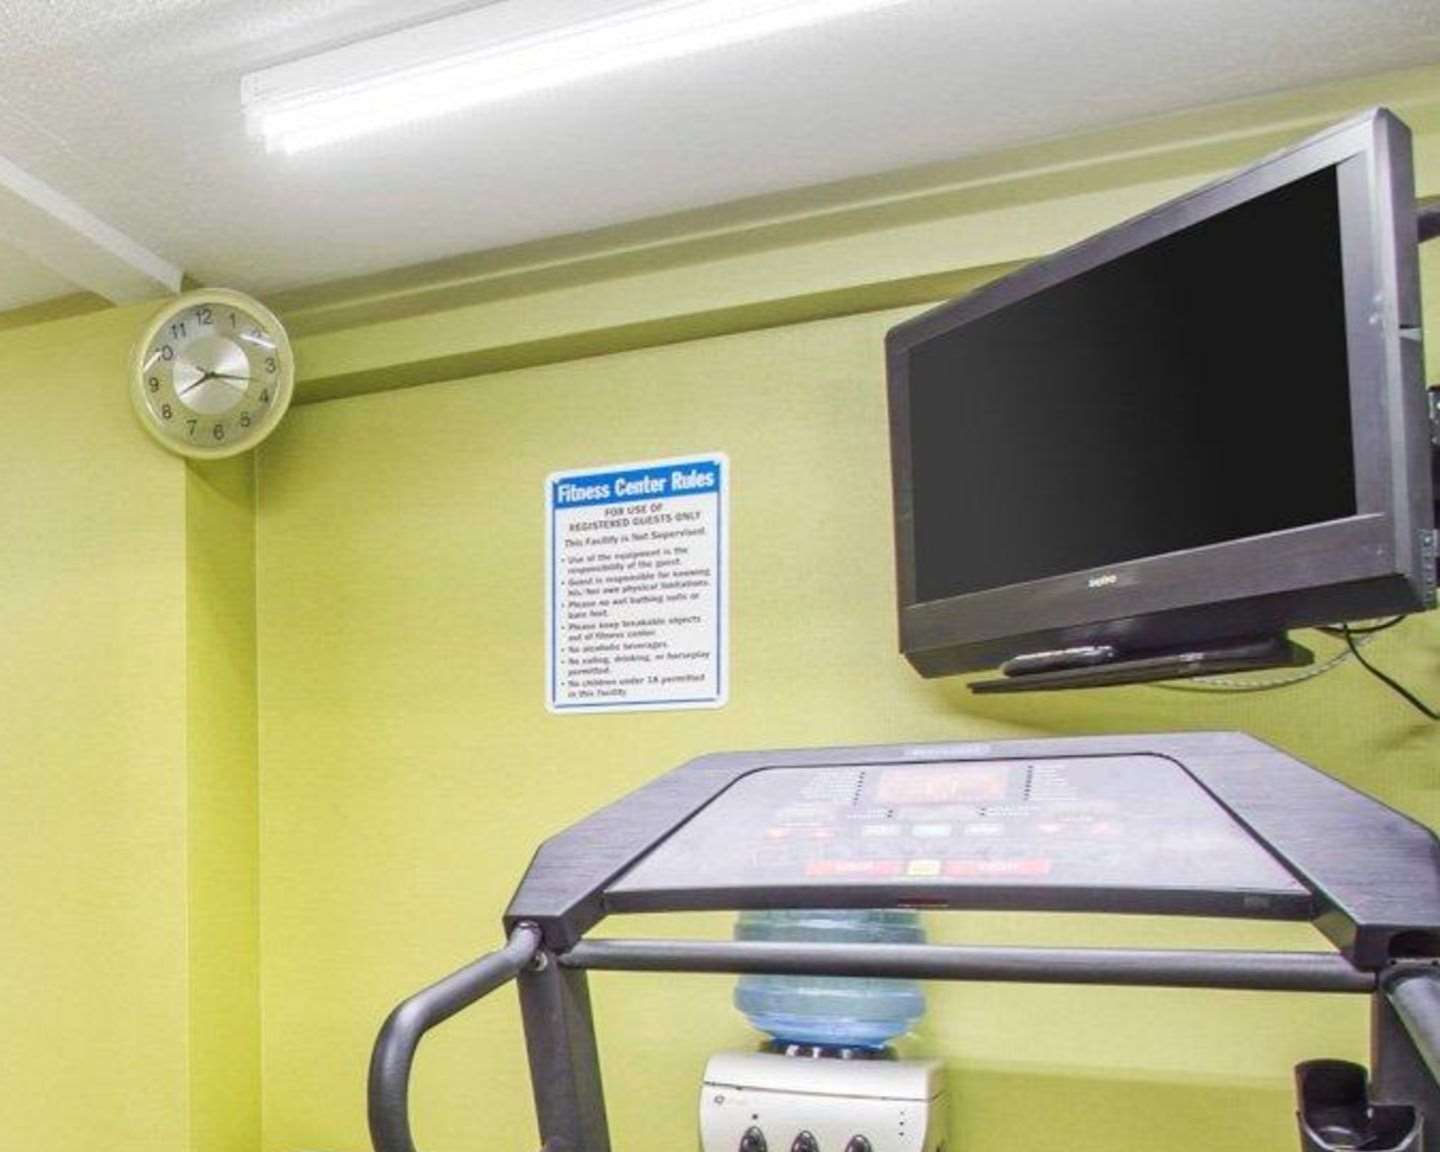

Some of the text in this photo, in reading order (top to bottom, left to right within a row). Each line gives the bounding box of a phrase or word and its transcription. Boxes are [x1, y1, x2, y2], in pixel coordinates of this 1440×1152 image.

[196, 308, 212, 326] 12
[229, 313, 236, 328] 1
[170, 322, 186, 340] 11
[264, 358, 276, 373] 3
[149, 377, 159, 392] 9
[260, 389, 269, 403] 4
[162, 404, 173, 420] 8
[240, 411, 251, 427] 5
[186, 419, 198, 435] 7
[213, 424, 225, 440] 6
[558, 469, 715, 503] Fitness Center Rules
[604, 502, 663, 517] FOR USE OF
[569, 511, 700, 532] REGISTERED GUESTS ONLY
[565, 539, 583, 548] This
[586, 535, 618, 547] Facility
[632, 532, 649, 541] Not
[587, 554, 596, 563] of
[598, 553, 611, 562] the
[615, 548, 660, 561] equipment
[674, 546, 688, 555] the
[627, 560, 636, 569] of
[638, 559, 652, 568] the
[661, 673, 704, 686] permitted
